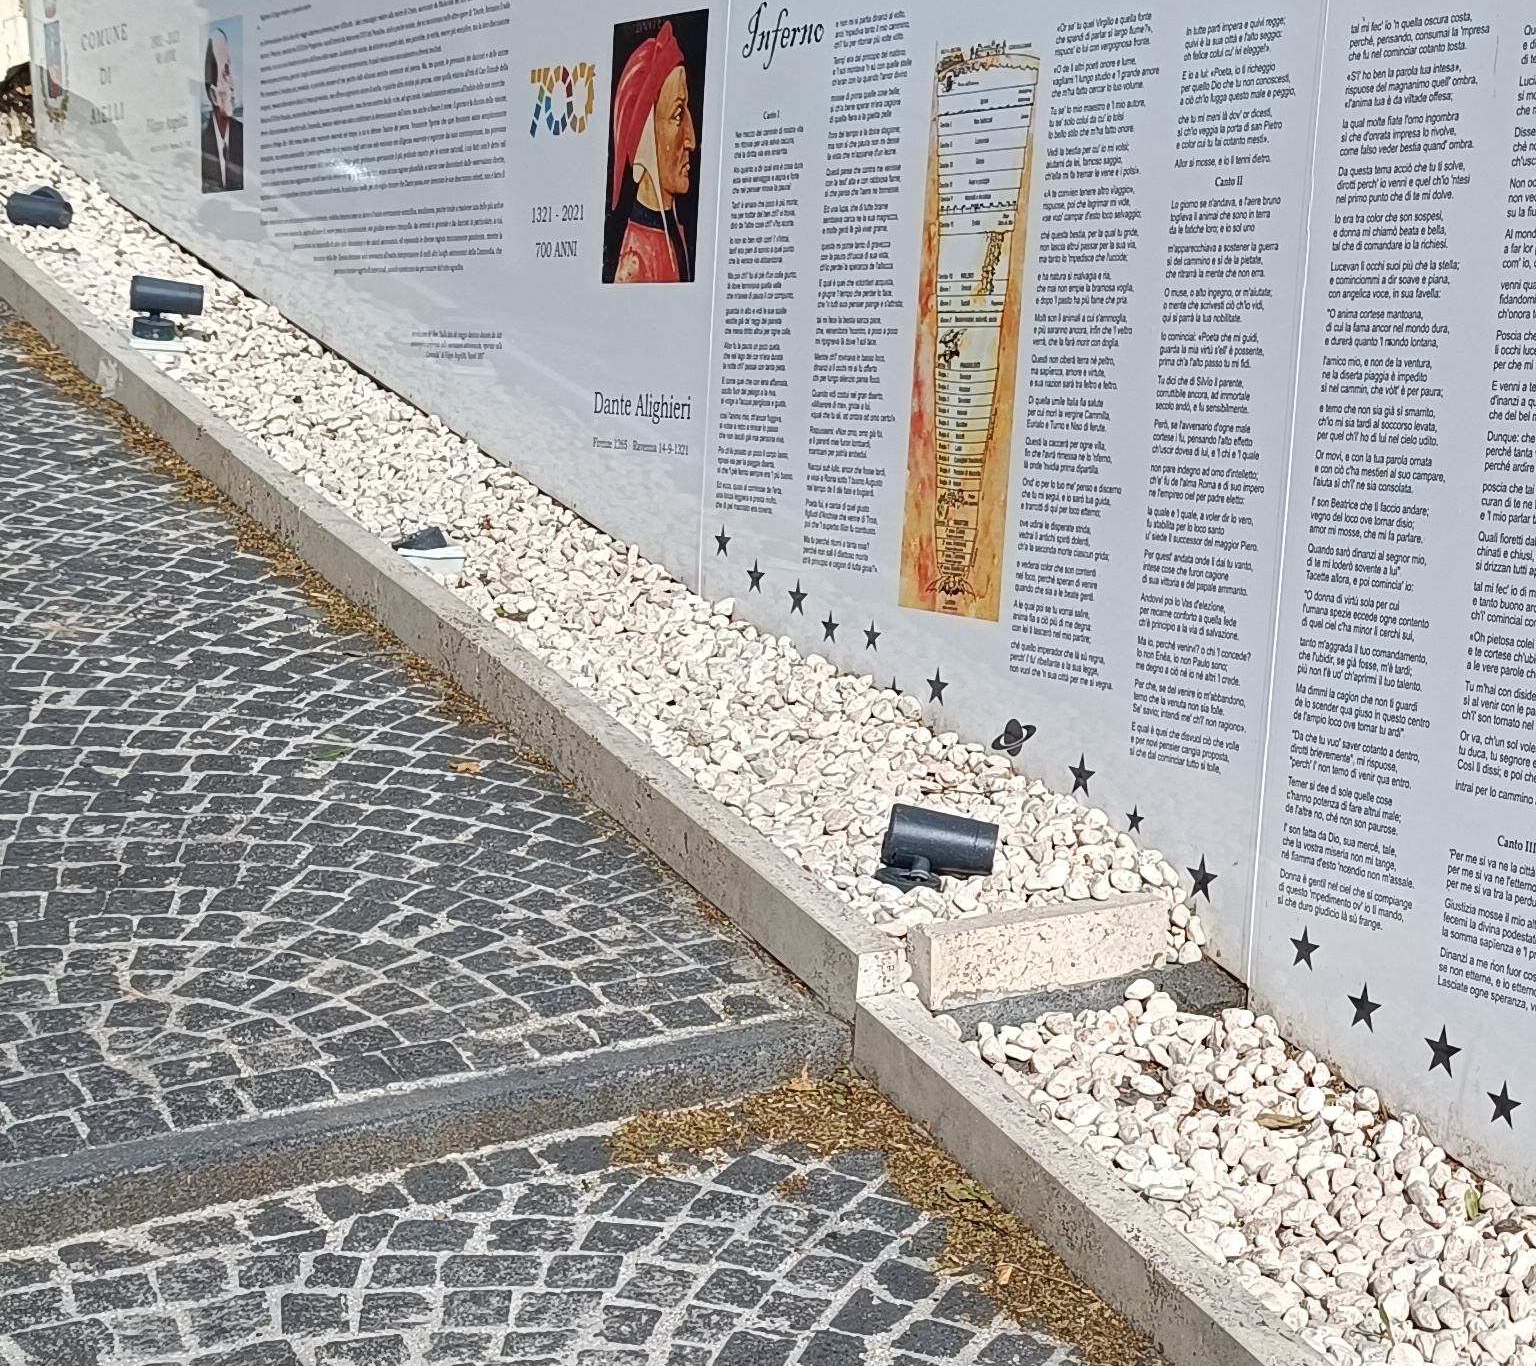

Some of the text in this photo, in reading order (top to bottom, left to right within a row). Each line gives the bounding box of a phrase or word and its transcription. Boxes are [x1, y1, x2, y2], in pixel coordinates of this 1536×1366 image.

[741, 1, 825, 70] Inferno
[531, 206, 552, 224] 1321
[561, 204, 584, 222] 2021
[535, 240, 578, 259] 700 ANNI
[593, 391, 691, 425] Dante Alighieri
[1497, 835, 1536, 854] Canto III
